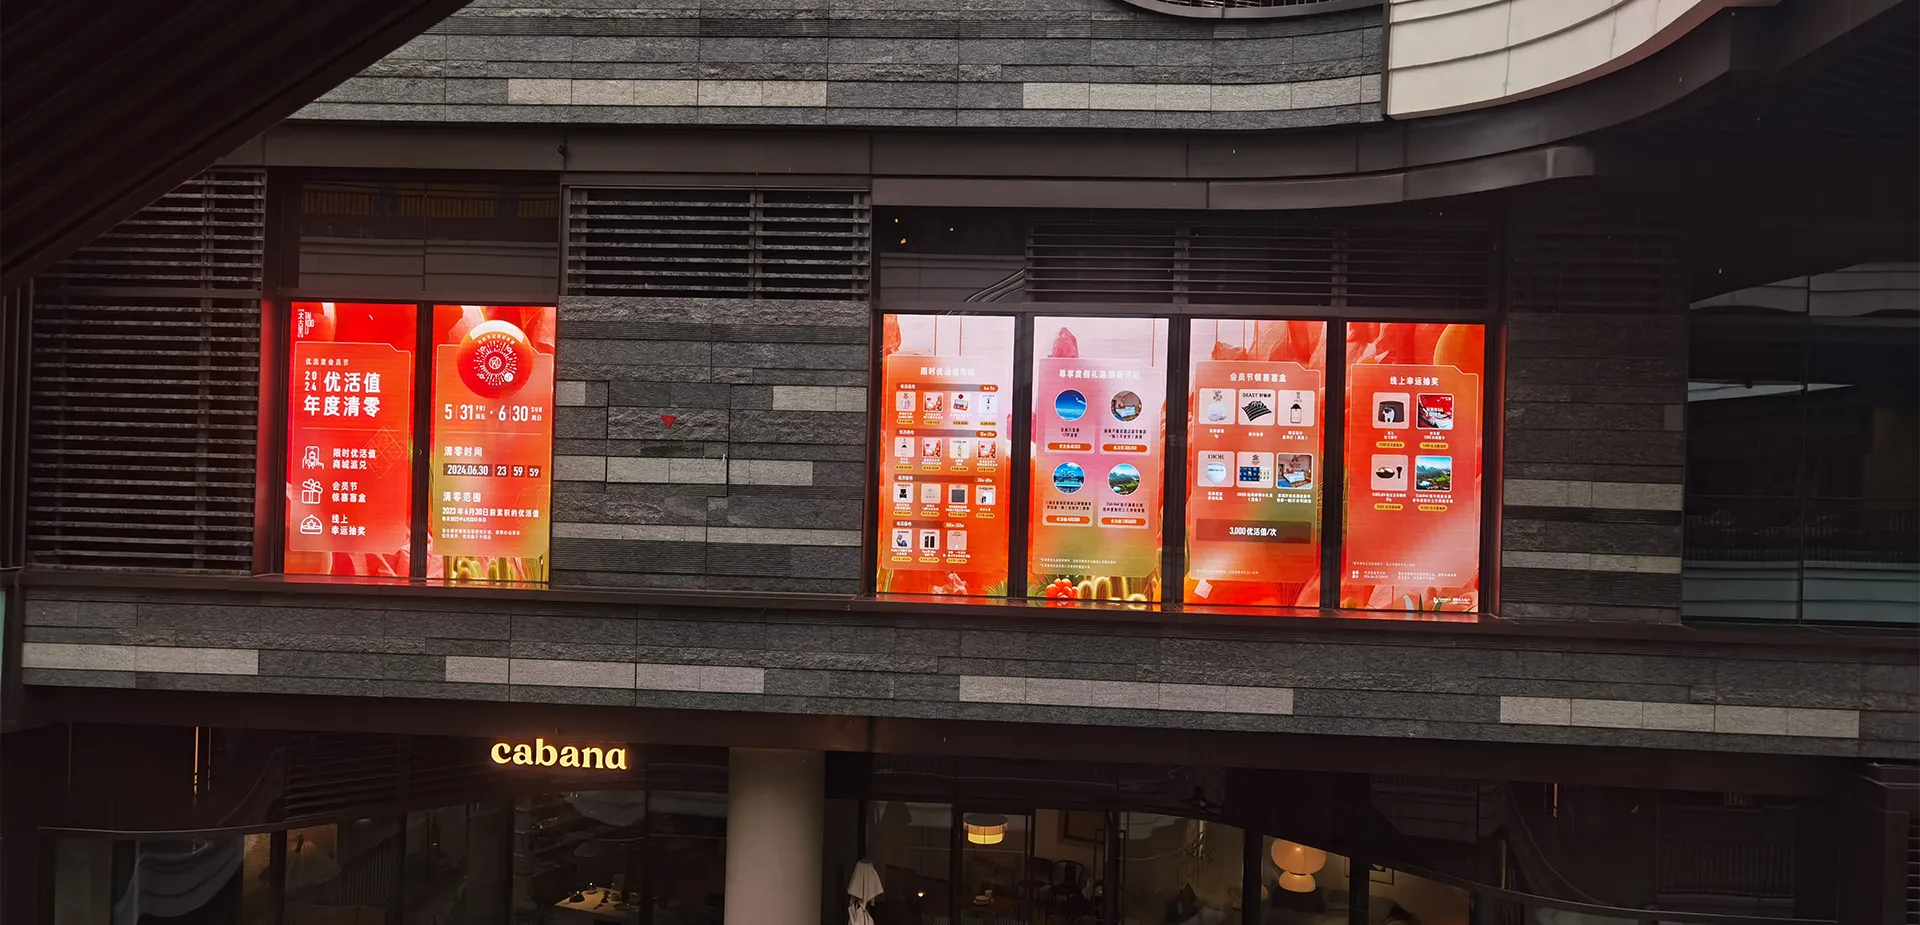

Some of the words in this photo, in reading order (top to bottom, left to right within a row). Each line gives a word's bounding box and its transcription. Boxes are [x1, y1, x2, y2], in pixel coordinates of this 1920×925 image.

[324, 371, 381, 393] 优活值
[1230, 372, 1287, 382] 会员节惊喜盲盒
[1389, 376, 1439, 386] 线上幸运抽奖
[303, 395, 381, 418] 年度清零
[332, 448, 376, 459] 限时优活值
[444, 446, 483, 457] 清零时间
[447, 465, 488, 475] 2024.06.30
[497, 465, 507, 476] 23
[513, 466, 523, 476] 59
[529, 468, 539, 477] 59
[332, 481, 358, 491] 会员节
[332, 493, 366, 503] 惊喜盲盒
[442, 491, 482, 502] 清零范围
[331, 514, 348, 524] 线上
[331, 526, 366, 536] 幸运抽奖
[490, 738, 627, 770] cabana
